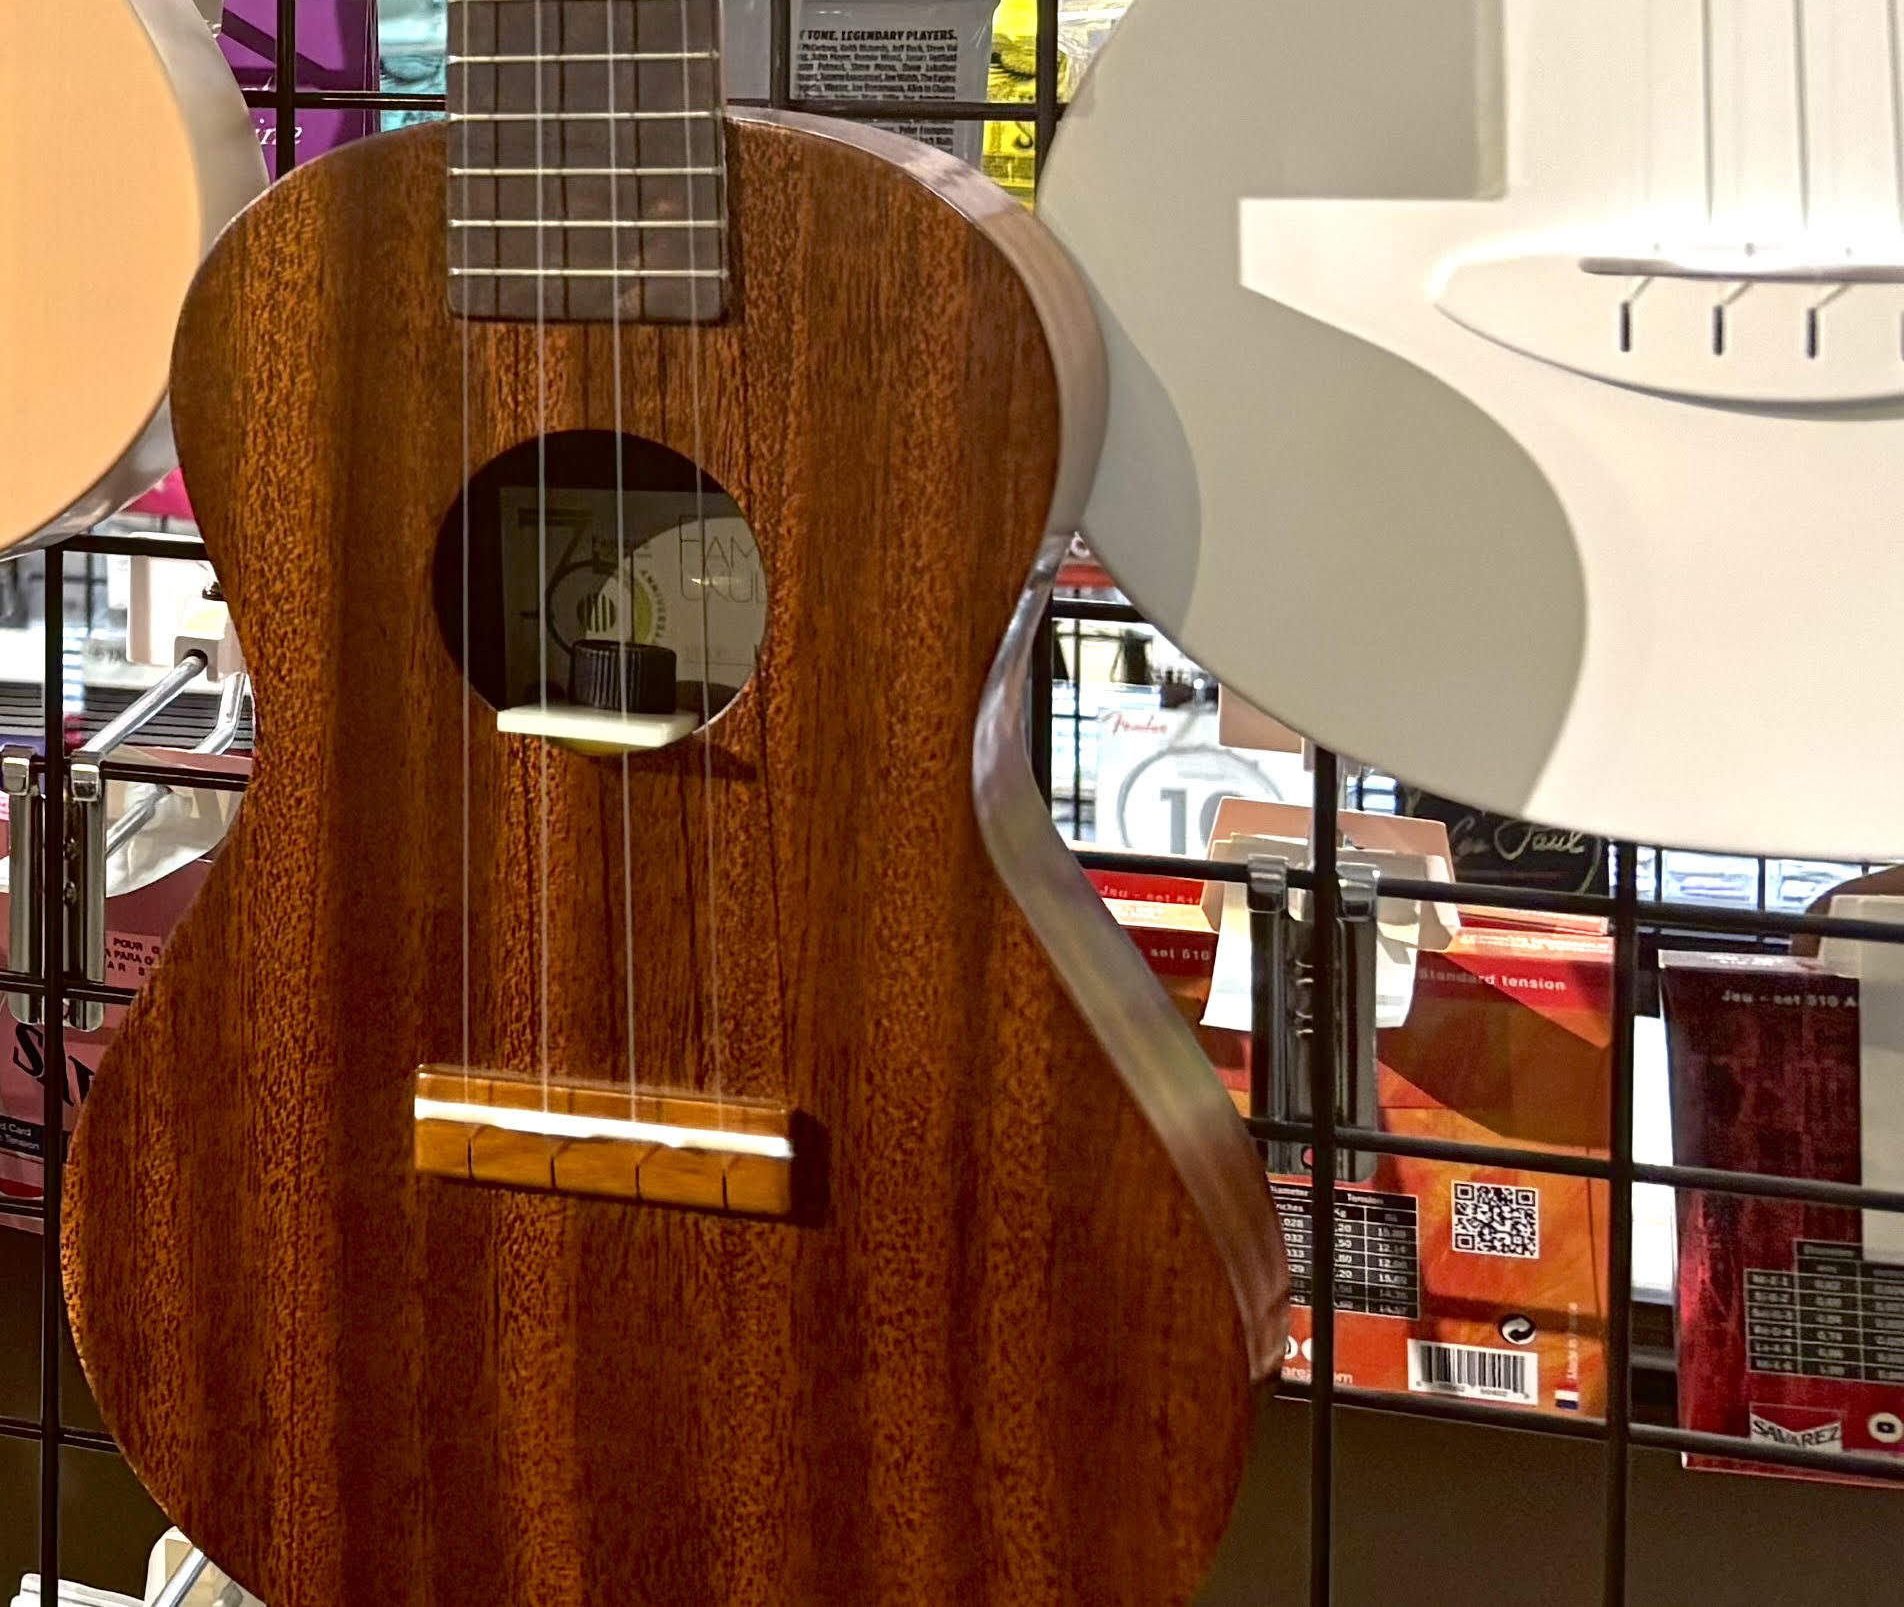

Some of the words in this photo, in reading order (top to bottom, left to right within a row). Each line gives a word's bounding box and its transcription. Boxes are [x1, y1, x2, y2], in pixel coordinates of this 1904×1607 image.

[808, 30, 838, 41] TONE.
[841, 30, 903, 41] LEGENDARY
[906, 29, 958, 40] PLAYERS.
[1502, 974, 1567, 993] tension
[1752, 1417, 1841, 1448] SAVAREZ
